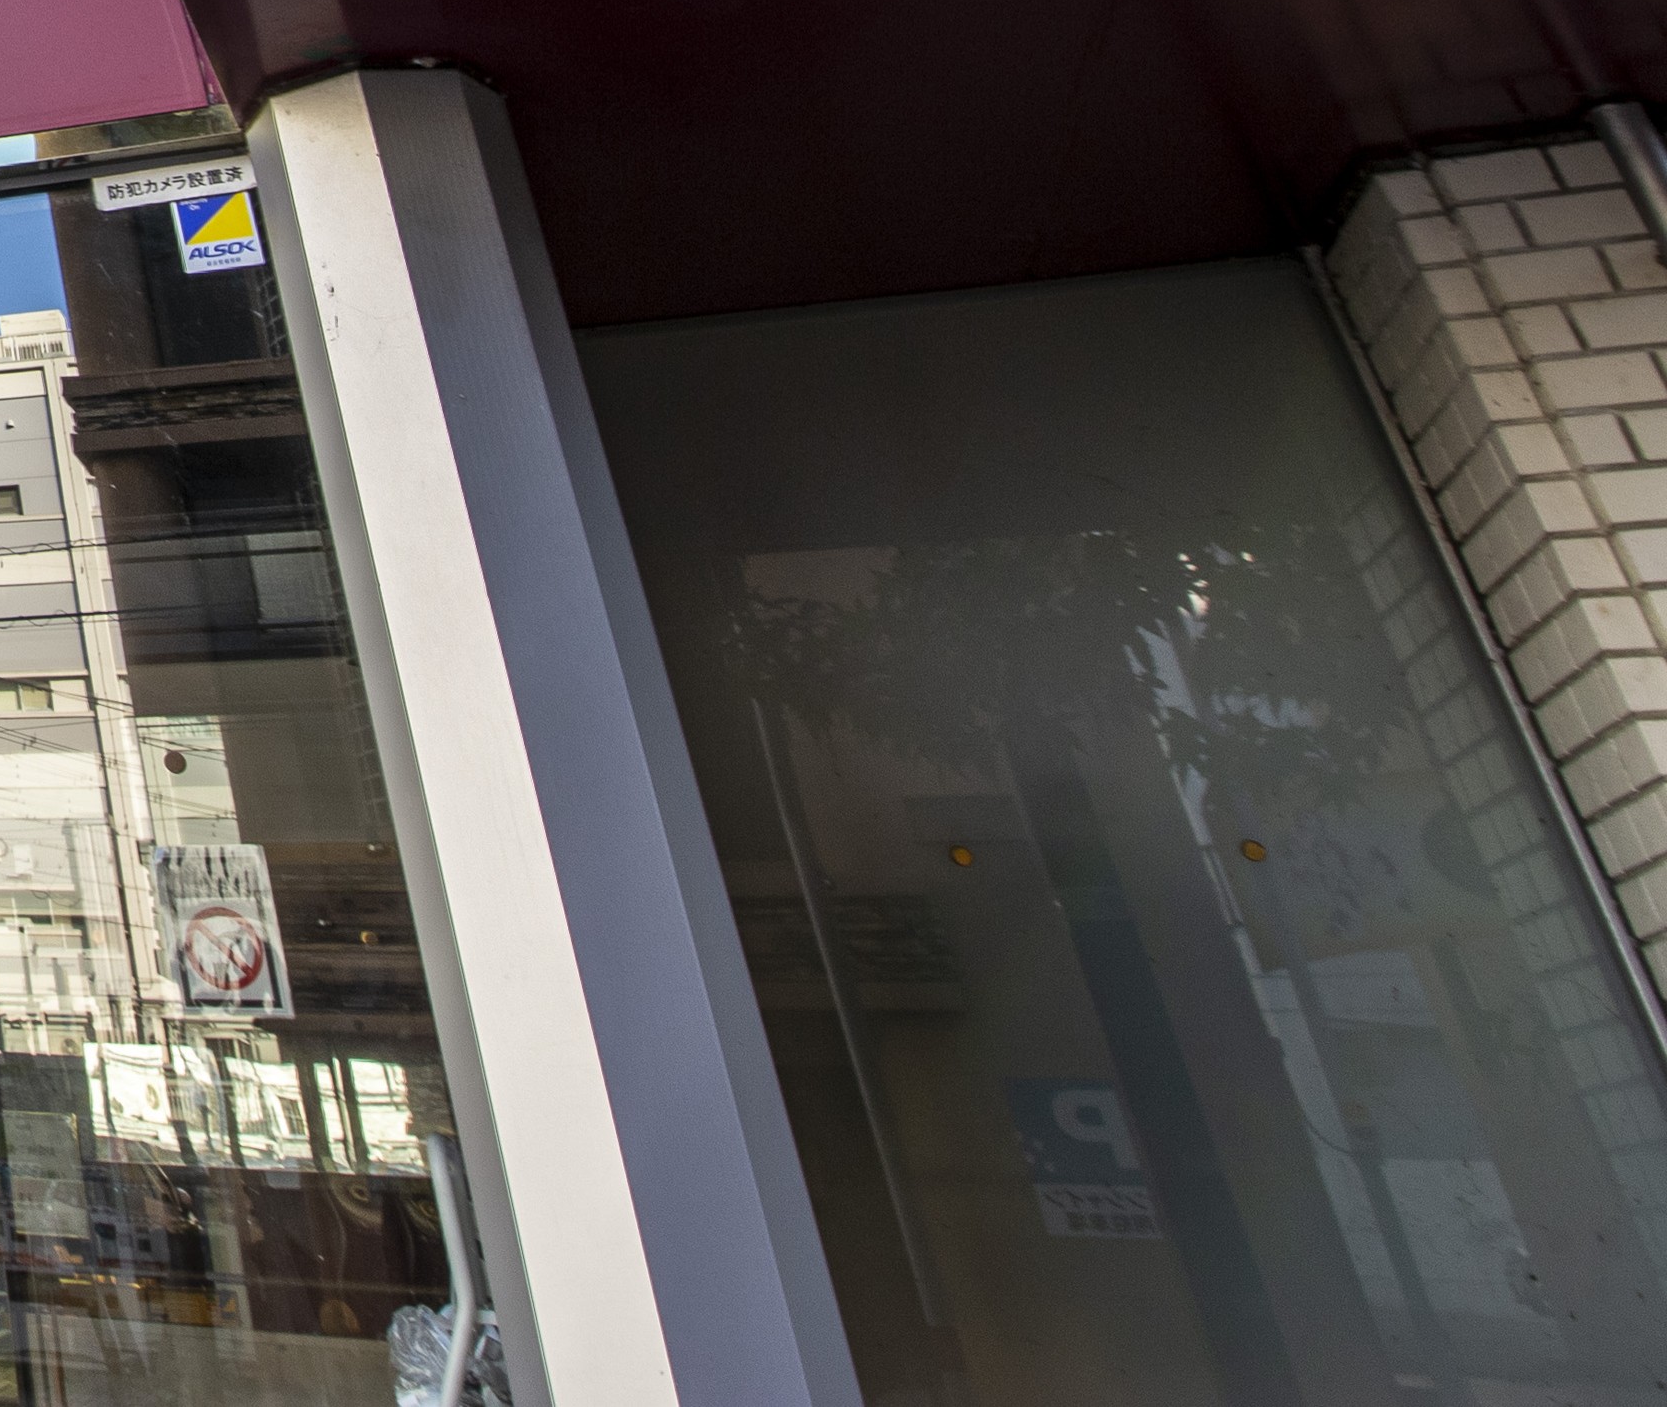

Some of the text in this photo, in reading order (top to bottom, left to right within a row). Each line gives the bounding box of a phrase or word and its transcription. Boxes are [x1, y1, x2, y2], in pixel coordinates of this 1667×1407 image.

[107, 166, 244, 201] 防犯カメラ設置済
[188, 239, 257, 260] ALSOK
